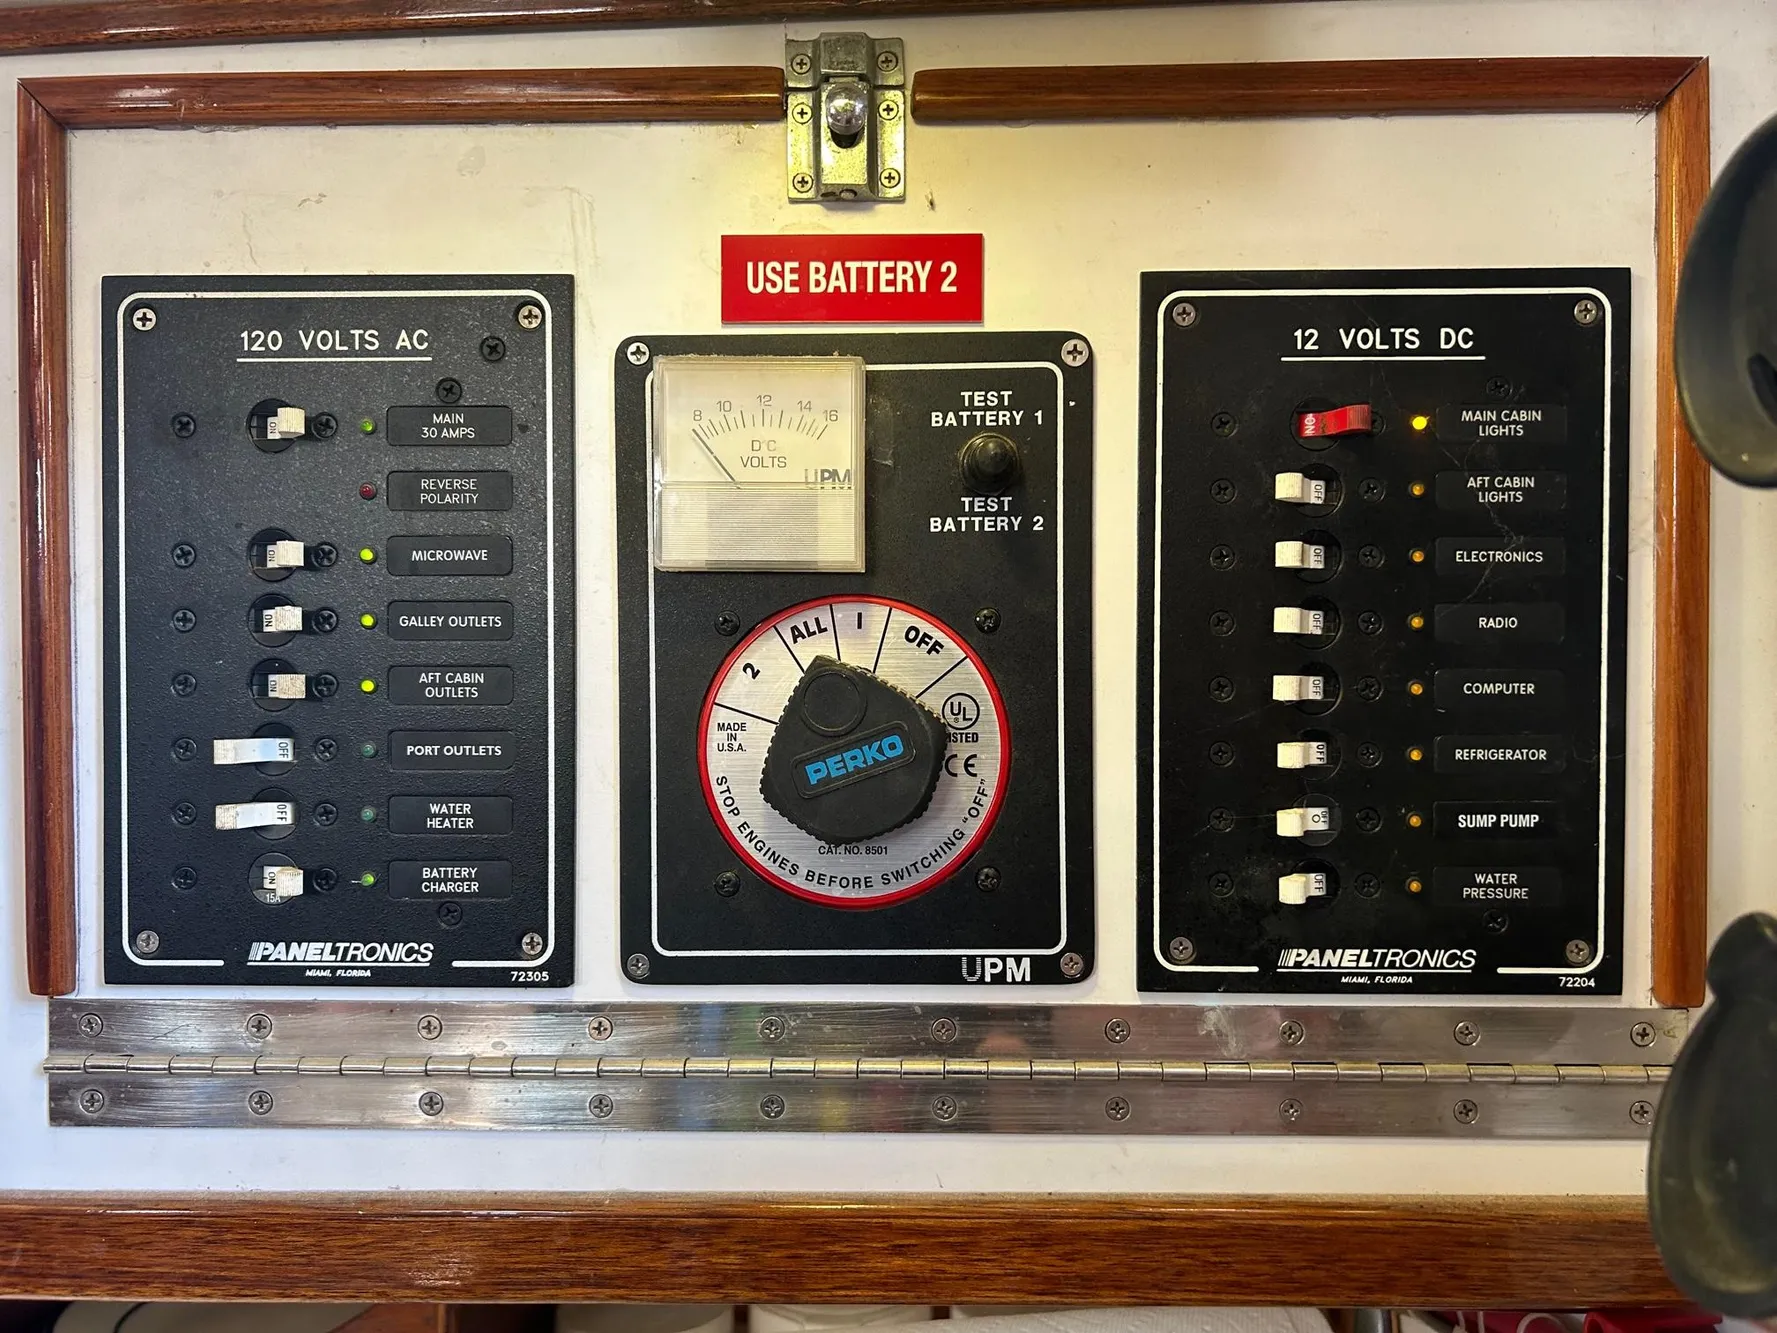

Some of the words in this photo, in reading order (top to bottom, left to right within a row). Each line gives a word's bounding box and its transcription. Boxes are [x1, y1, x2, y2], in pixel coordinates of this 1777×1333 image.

[746, 261, 800, 294] USE
[809, 260, 933, 294] BATTERY
[940, 260, 957, 293] 2
[240, 330, 283, 352] 120
[298, 329, 380, 351] VOLTS
[395, 328, 429, 350] AC
[1293, 328, 1319, 350] 12
[1338, 327, 1420, 350] VOLTS
[1440, 327, 1474, 349] DC
[756, 395, 772, 406] 12
[960, 390, 1013, 407] TEST
[716, 400, 732, 412] 10
[797, 400, 812, 412] 14
[433, 412, 464, 424] MAIN
[693, 409, 703, 422] 8
[823, 409, 839, 422] 16
[931, 410, 1024, 427] BATTERY
[1034, 409, 1043, 425] 1
[1461, 410, 1497, 422] MAIN
[1502, 409, 1542, 422] CABIN
[421, 427, 438, 439] 30
[440, 427, 475, 439] AMPS
[1479, 424, 1524, 437] LIGHTS
[740, 456, 787, 468] VOLTS
[421, 478, 477, 490] REVERSE
[804, 468, 852, 489] UPM
[1466, 476, 1490, 488] AFT
[1494, 476, 1535, 488] CABIN
[420, 493, 479, 504] POLARITY
[1314, 484, 1322, 501] OFF
[1478, 491, 1524, 503] LIGHTS
[960, 496, 1013, 513] TEST
[929, 516, 1023, 533] BATTERY
[1032, 515, 1044, 531] 2
[411, 549, 488, 562] MICROWAVE
[1313, 548, 1322, 565] OFF
[1455, 550, 1544, 563] ELECTRONICS
[399, 615, 445, 627] GALLEY
[448, 615, 502, 628] OUTLETS
[1312, 613, 1321, 632] OFF
[1478, 617, 1518, 629] RADIO
[789, 616, 828, 644] ALL
[904, 625, 945, 656] OFF
[742, 662, 760, 680] 2
[418, 672, 442, 684] AFT
[446, 672, 484, 684] CABIN
[425, 686, 479, 698] OUTLETS
[1312, 679, 1321, 696] OFF
[1463, 682, 1535, 695] COMPUTER
[717, 722, 747, 732] MADE
[727, 733, 737, 742] IN
[946, 732, 979, 743] ISTED
[278, 741, 289, 759] OFF
[406, 745, 441, 756] PORT
[443, 745, 502, 756] OUTLETS
[717, 743, 747, 752] U.S.A.
[1316, 744, 1325, 763] OFF
[804, 734, 904, 785] PERKO
[1455, 748, 1547, 761] REFRIGERATOR
[944, 753, 978, 778] CE
[276, 804, 287, 822] OFF
[429, 803, 472, 815] WATER
[426, 817, 474, 829] HEATER
[1458, 814, 1497, 828] SUMP
[1500, 814, 1540, 828] PUMP
[715, 773, 741, 819] STOP
[737, 820, 800, 877] ENGINES
[804, 868, 875, 891] BEFORE
[880, 828, 966, 887] SWITCHING
[818, 846, 841, 855] CAT.
[844, 846, 863, 855] NO.
[865, 846, 888, 855] 8501
[422, 867, 478, 879] BATTERY
[1474, 873, 1518, 885] WATER
[421, 881, 479, 893] CHARGER
[1315, 874, 1324, 893] OFF
[1462, 887, 1529, 899] PRESSURE
[248, 941, 435, 963] PANELTRONICS
[1277, 948, 1477, 969] PANELTRONICS
[336, 969, 371, 977] FLORIDA
[961, 956, 1031, 983] UPM
[510, 971, 550, 982] 72305
[1340, 976, 1371, 984] MIAMI,
[1374, 975, 1413, 984] FLORIDA
[1558, 976, 1596, 988] 72204
